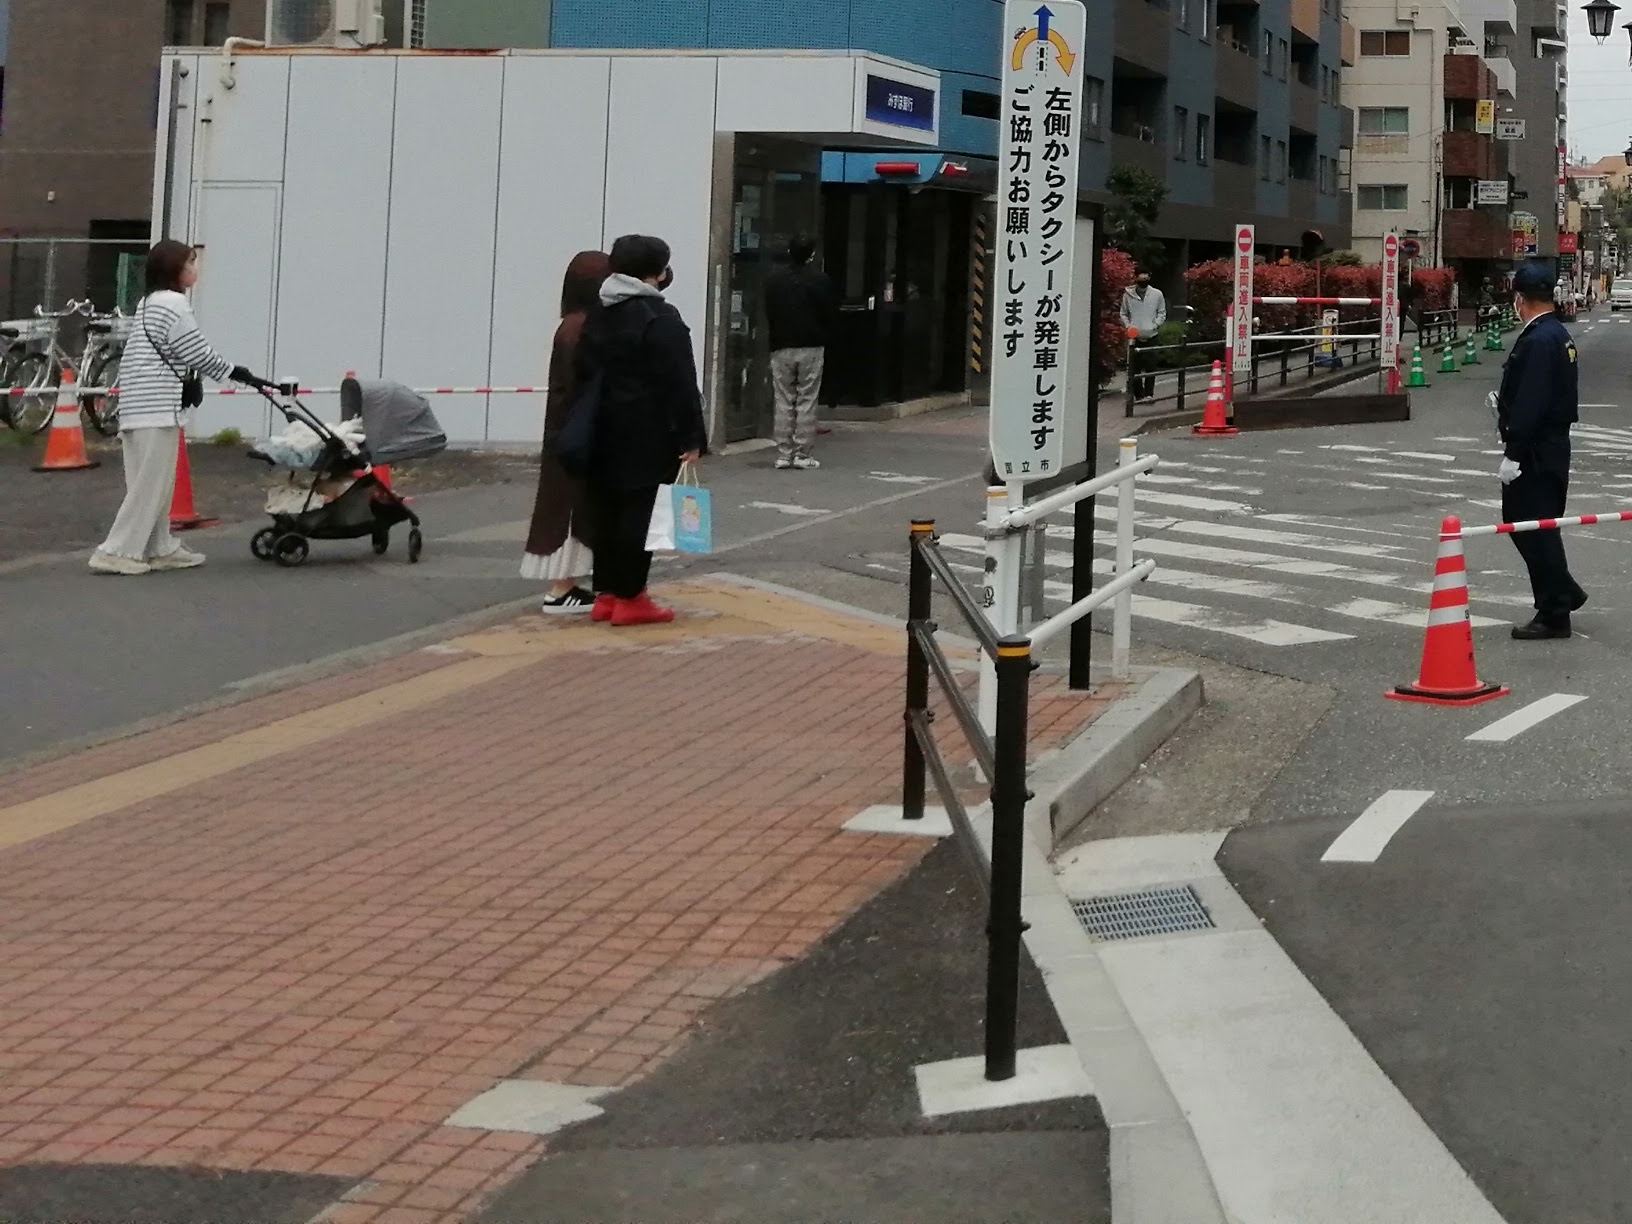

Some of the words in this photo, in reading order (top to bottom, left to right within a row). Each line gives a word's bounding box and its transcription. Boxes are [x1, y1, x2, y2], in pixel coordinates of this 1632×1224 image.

[1002, 86, 1034, 360] ご協力お願いします
[1029, 87, 1073, 452] 左側からタクシーが発車します
[1237, 255, 1250, 358] 車両進入禁止
[1384, 260, 1396, 354] 車両進入禁止
[1004, 457, 1050, 474] 国立市
